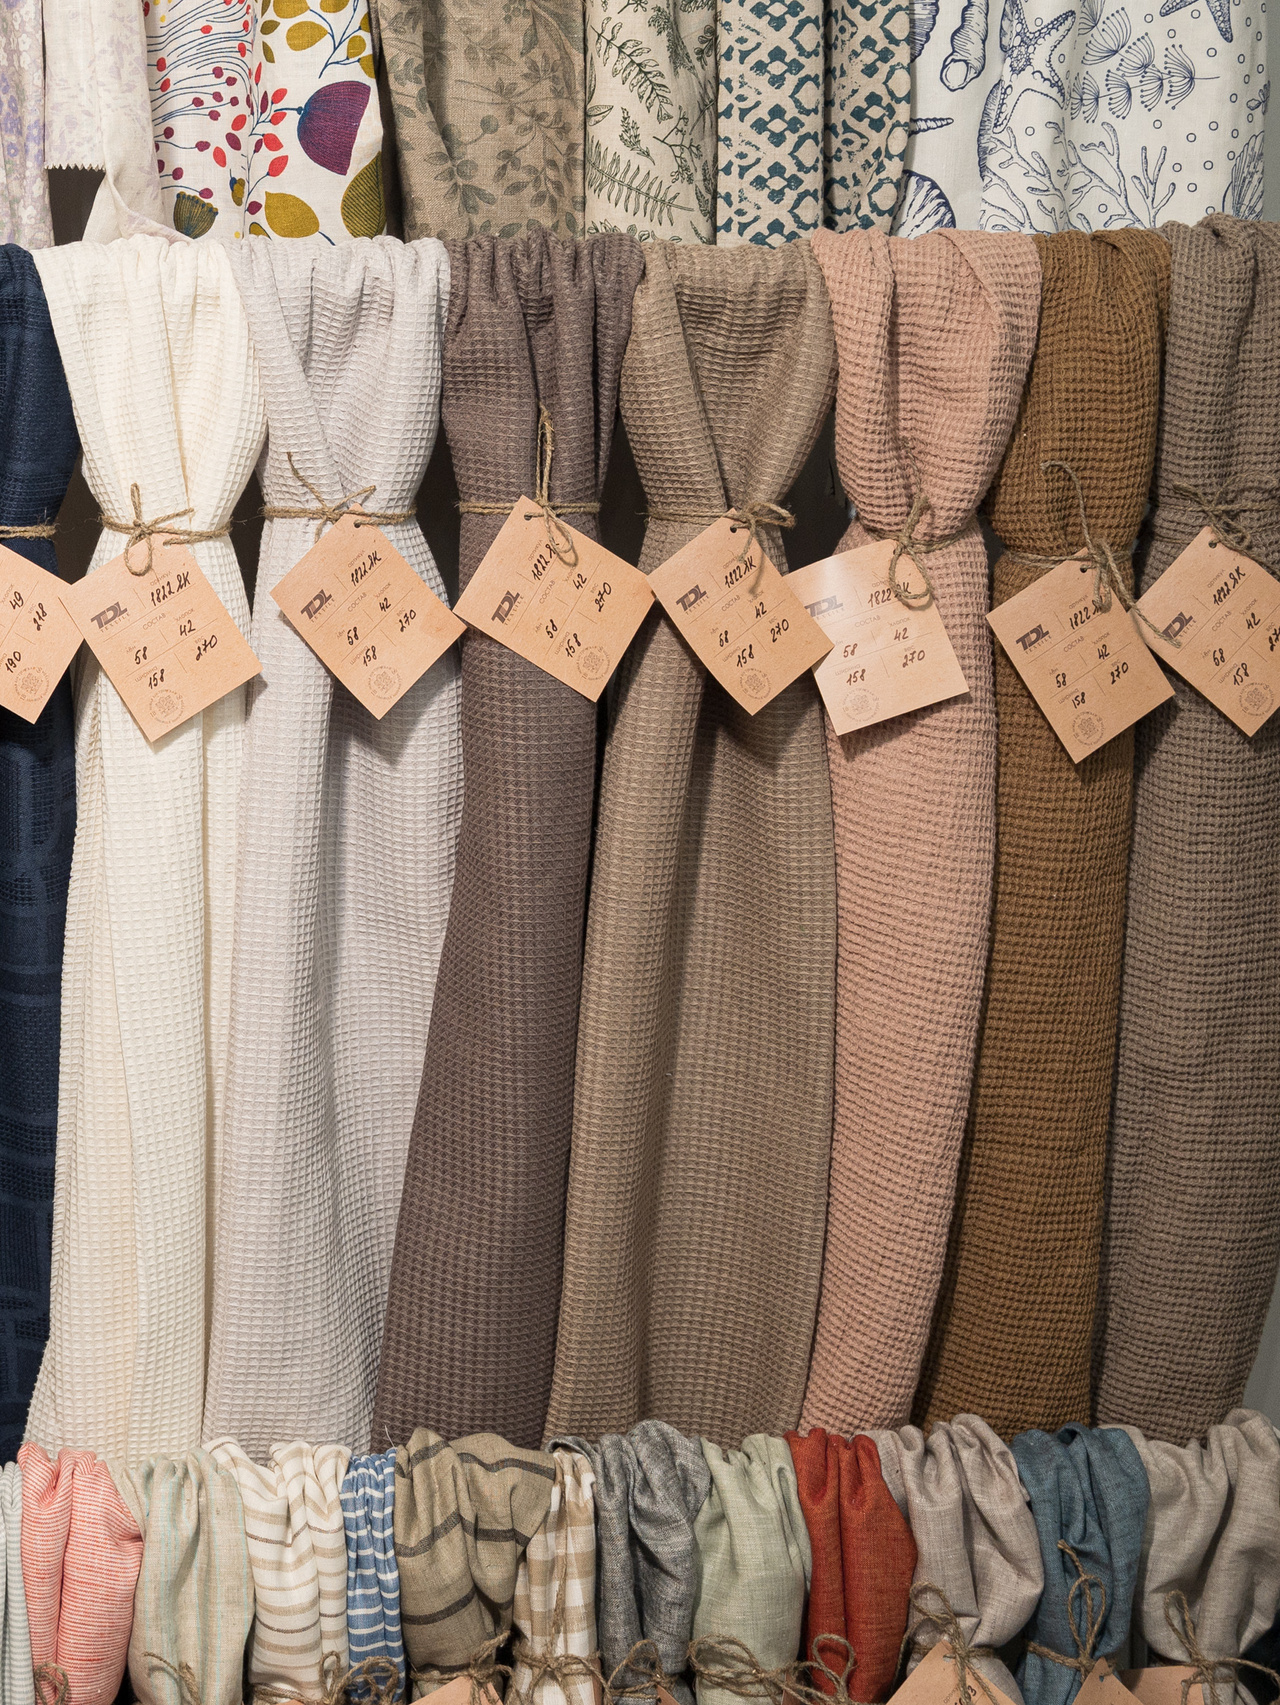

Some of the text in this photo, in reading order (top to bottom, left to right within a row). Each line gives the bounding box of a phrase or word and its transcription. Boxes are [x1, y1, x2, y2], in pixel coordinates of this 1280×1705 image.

[572, 573, 588, 590] 42
[9, 591, 25, 610] 49
[347, 592, 368, 613] СОСТАВ
[539, 580, 556, 605] СОСТАВ
[594, 582, 612, 612] 270
[676, 584, 707, 612] TDL
[721, 594, 741, 612] СОСТАВ
[868, 588, 892, 608] 1822
[1213, 582, 1232, 606] 1822
[300, 589, 332, 620] TDL
[379, 597, 392, 613] 42
[491, 590, 520, 624] TDL
[755, 601, 767, 619] 42
[804, 595, 843, 617] TDL
[32, 602, 48, 631] 218
[90, 601, 128, 630] TDL
[142, 612, 167, 631] СОСТАВ
[399, 609, 417, 633] 270
[854, 615, 881, 628] СОСТАВ
[1069, 607, 1091, 630] 1822
[1211, 610, 1232, 632] СОСТАВ
[1246, 612, 1261, 630] 42
[179, 619, 196, 637] 42
[347, 626, 359, 646] 58
[545, 619, 558, 639] 58
[770, 618, 789, 643] 270
[894, 627, 909, 641] 42
[1015, 624, 1049, 652] TDL
[1269, 625, 1280, 652] 27
[195, 634, 218, 661] 270
[565, 633, 582, 658] 158
[843, 643, 858, 658] 58
[1063, 636, 1085, 653] СОСТАВ
[1097, 644, 1110, 660] 42
[5, 651, 22, 674] 190
[134, 646, 148, 665] 58
[363, 645, 377, 667] 158
[737, 643, 755, 668] 158
[902, 650, 925, 668] 270
[148, 668, 165, 689] 158
[846, 668, 866, 686] 158
[1055, 672, 1067, 688] 58
[1110, 662, 1129, 685] 270
[1233, 662, 1250, 686] 158
[1072, 692, 1086, 709] 158
